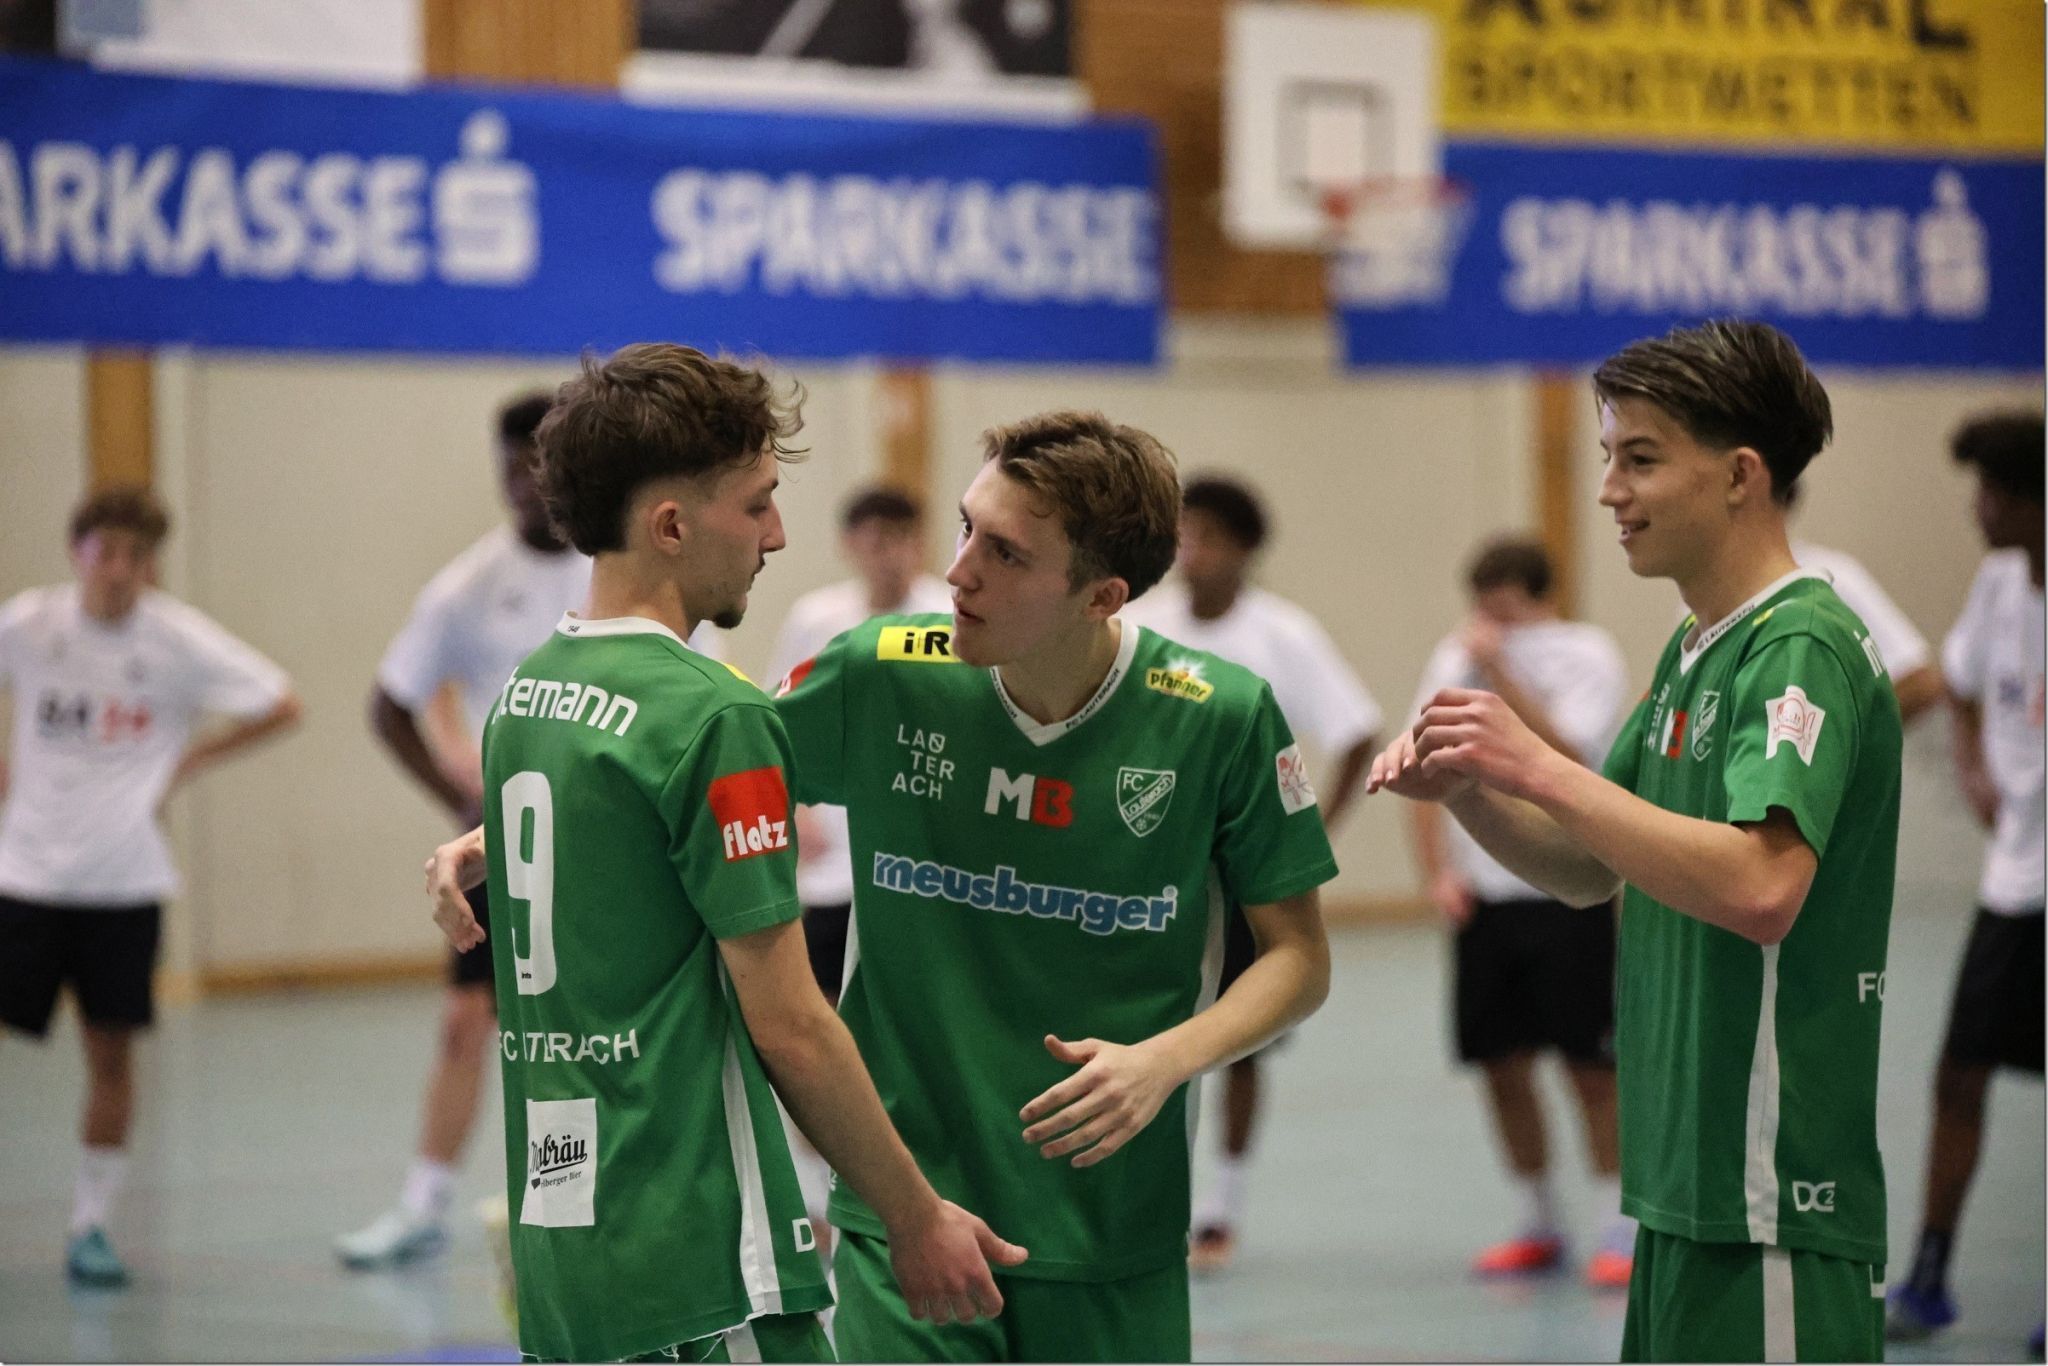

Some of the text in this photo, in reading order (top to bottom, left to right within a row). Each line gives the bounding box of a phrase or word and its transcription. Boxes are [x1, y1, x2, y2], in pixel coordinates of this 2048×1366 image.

[652, 170, 1156, 302] SPARKASSE
[491, 666, 638, 737] temann
[892, 772, 943, 800] ACH
[910, 750, 955, 781] TER
[984, 767, 1074, 829] MB
[1123, 772, 1144, 792] FC
[502, 771, 557, 996] 9
[873, 851, 1178, 936] meusburger
